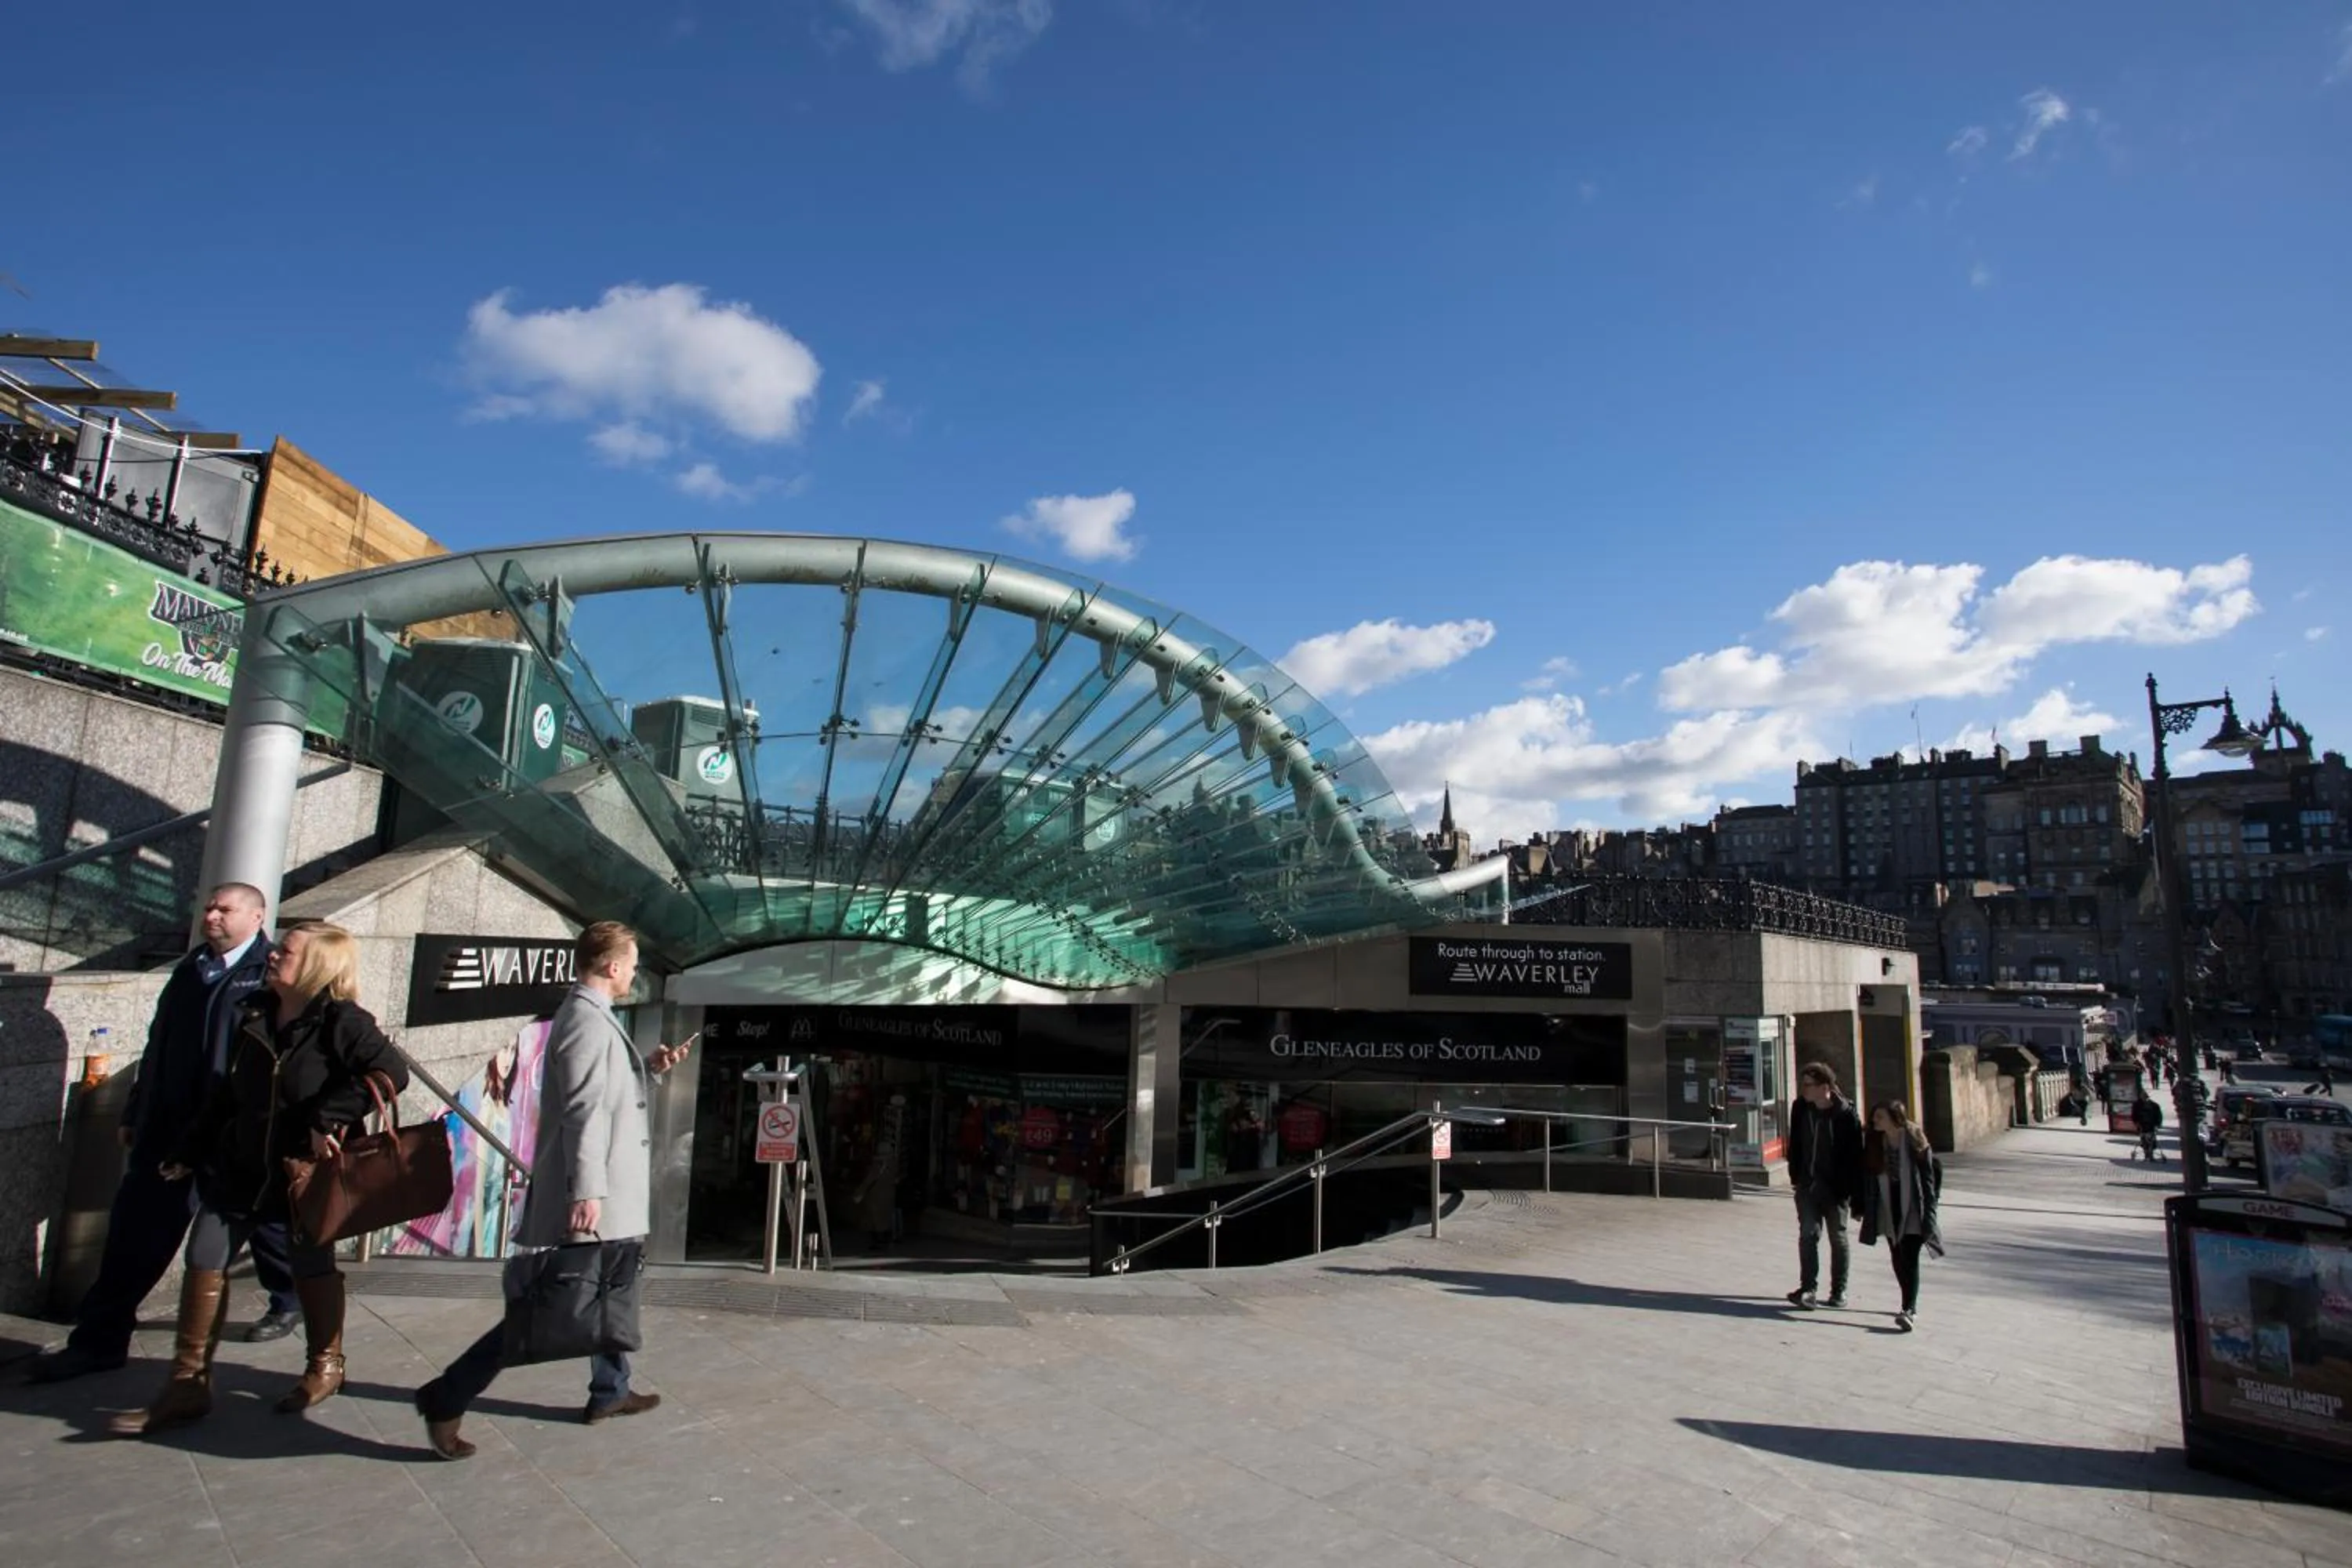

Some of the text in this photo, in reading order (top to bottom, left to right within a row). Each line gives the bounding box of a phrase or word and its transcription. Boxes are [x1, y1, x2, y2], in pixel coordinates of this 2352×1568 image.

[142, 642, 233, 688] On The Ma
[1438, 942, 1478, 957] Route
[1481, 943, 1534, 963] through
[1539, 948, 1553, 960] to
[481, 946, 578, 986] WAVERL
[1475, 964, 1599, 984] WAVERLEY
[1564, 980, 1591, 995] mall
[838, 1009, 1003, 1047] GLENEAGLES OF SCOTLAND
[1270, 1033, 1541, 1061] GLENEAGLES OF SCOTLAND
[2242, 1201, 2296, 1218] GAME
